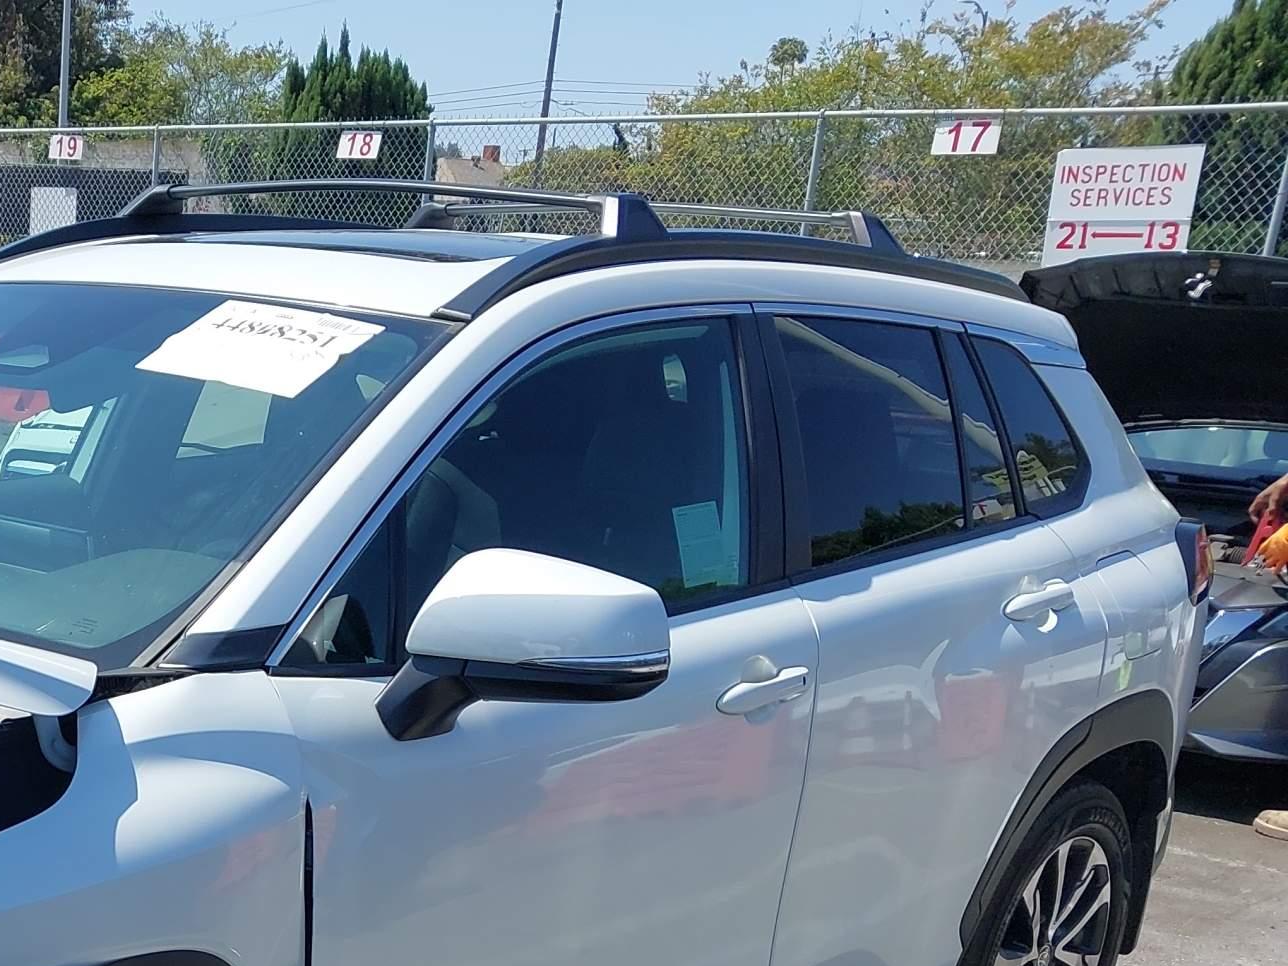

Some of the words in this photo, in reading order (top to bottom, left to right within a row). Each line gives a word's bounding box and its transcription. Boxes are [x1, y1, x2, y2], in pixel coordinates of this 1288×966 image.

[56, 136, 78, 157] 19
[347, 132, 374, 156] 18
[947, 120, 992, 152] 17
[1060, 163, 1187, 184] INSPECTION
[1069, 187, 1173, 207] SERVICES
[1056, 222, 1089, 249] 21
[1143, 221, 1181, 250] 13
